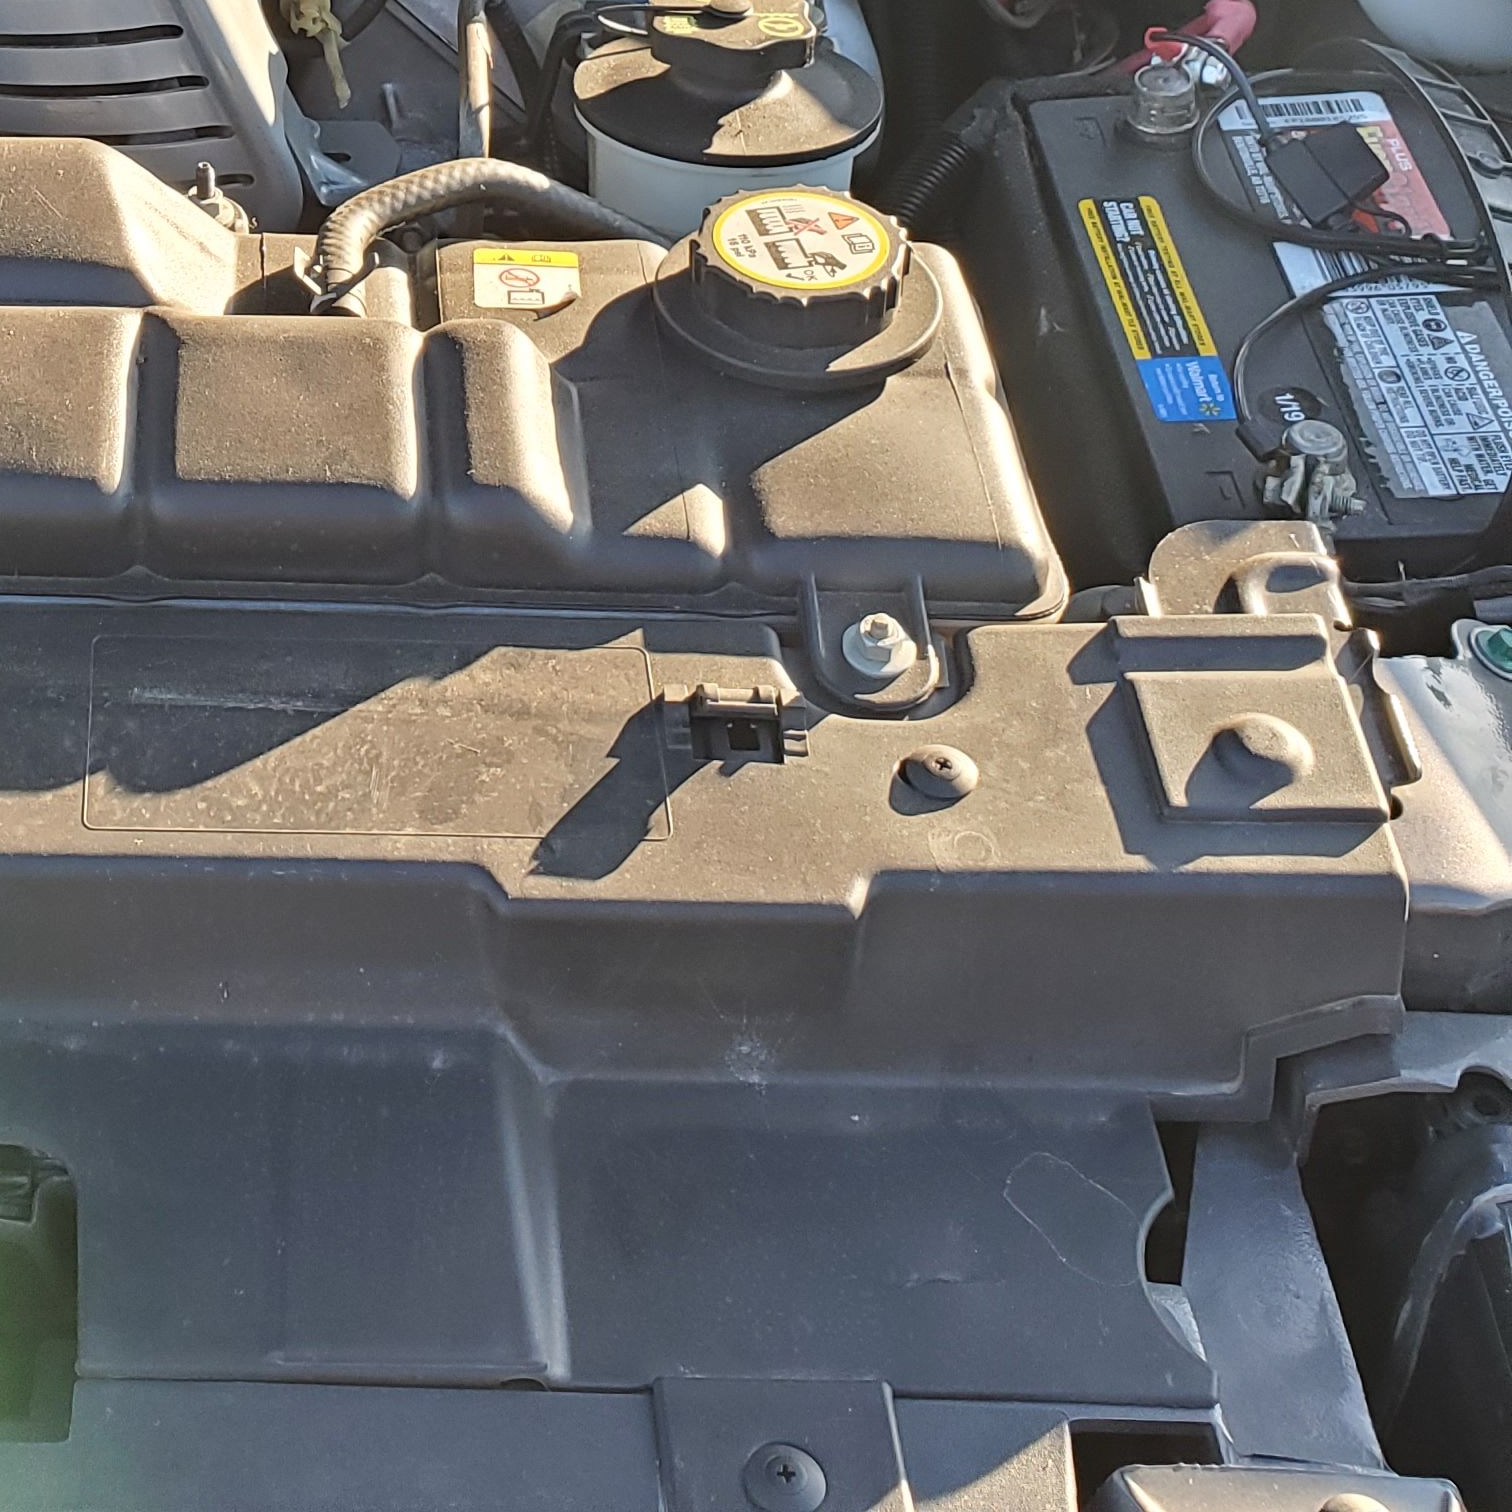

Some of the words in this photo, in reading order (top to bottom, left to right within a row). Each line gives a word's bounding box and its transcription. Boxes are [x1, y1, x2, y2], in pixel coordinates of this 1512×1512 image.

[1388, 137, 1413, 171] PLUS
[1102, 200, 1131, 243] STARTING?
[1119, 202, 1136, 220] CAR
[1127, 218, 1145, 236] NOT
[803, 269, 818, 281] OK
[1185, 360, 1213, 403] Walmart
[1274, 392, 1306, 422] 1/19
